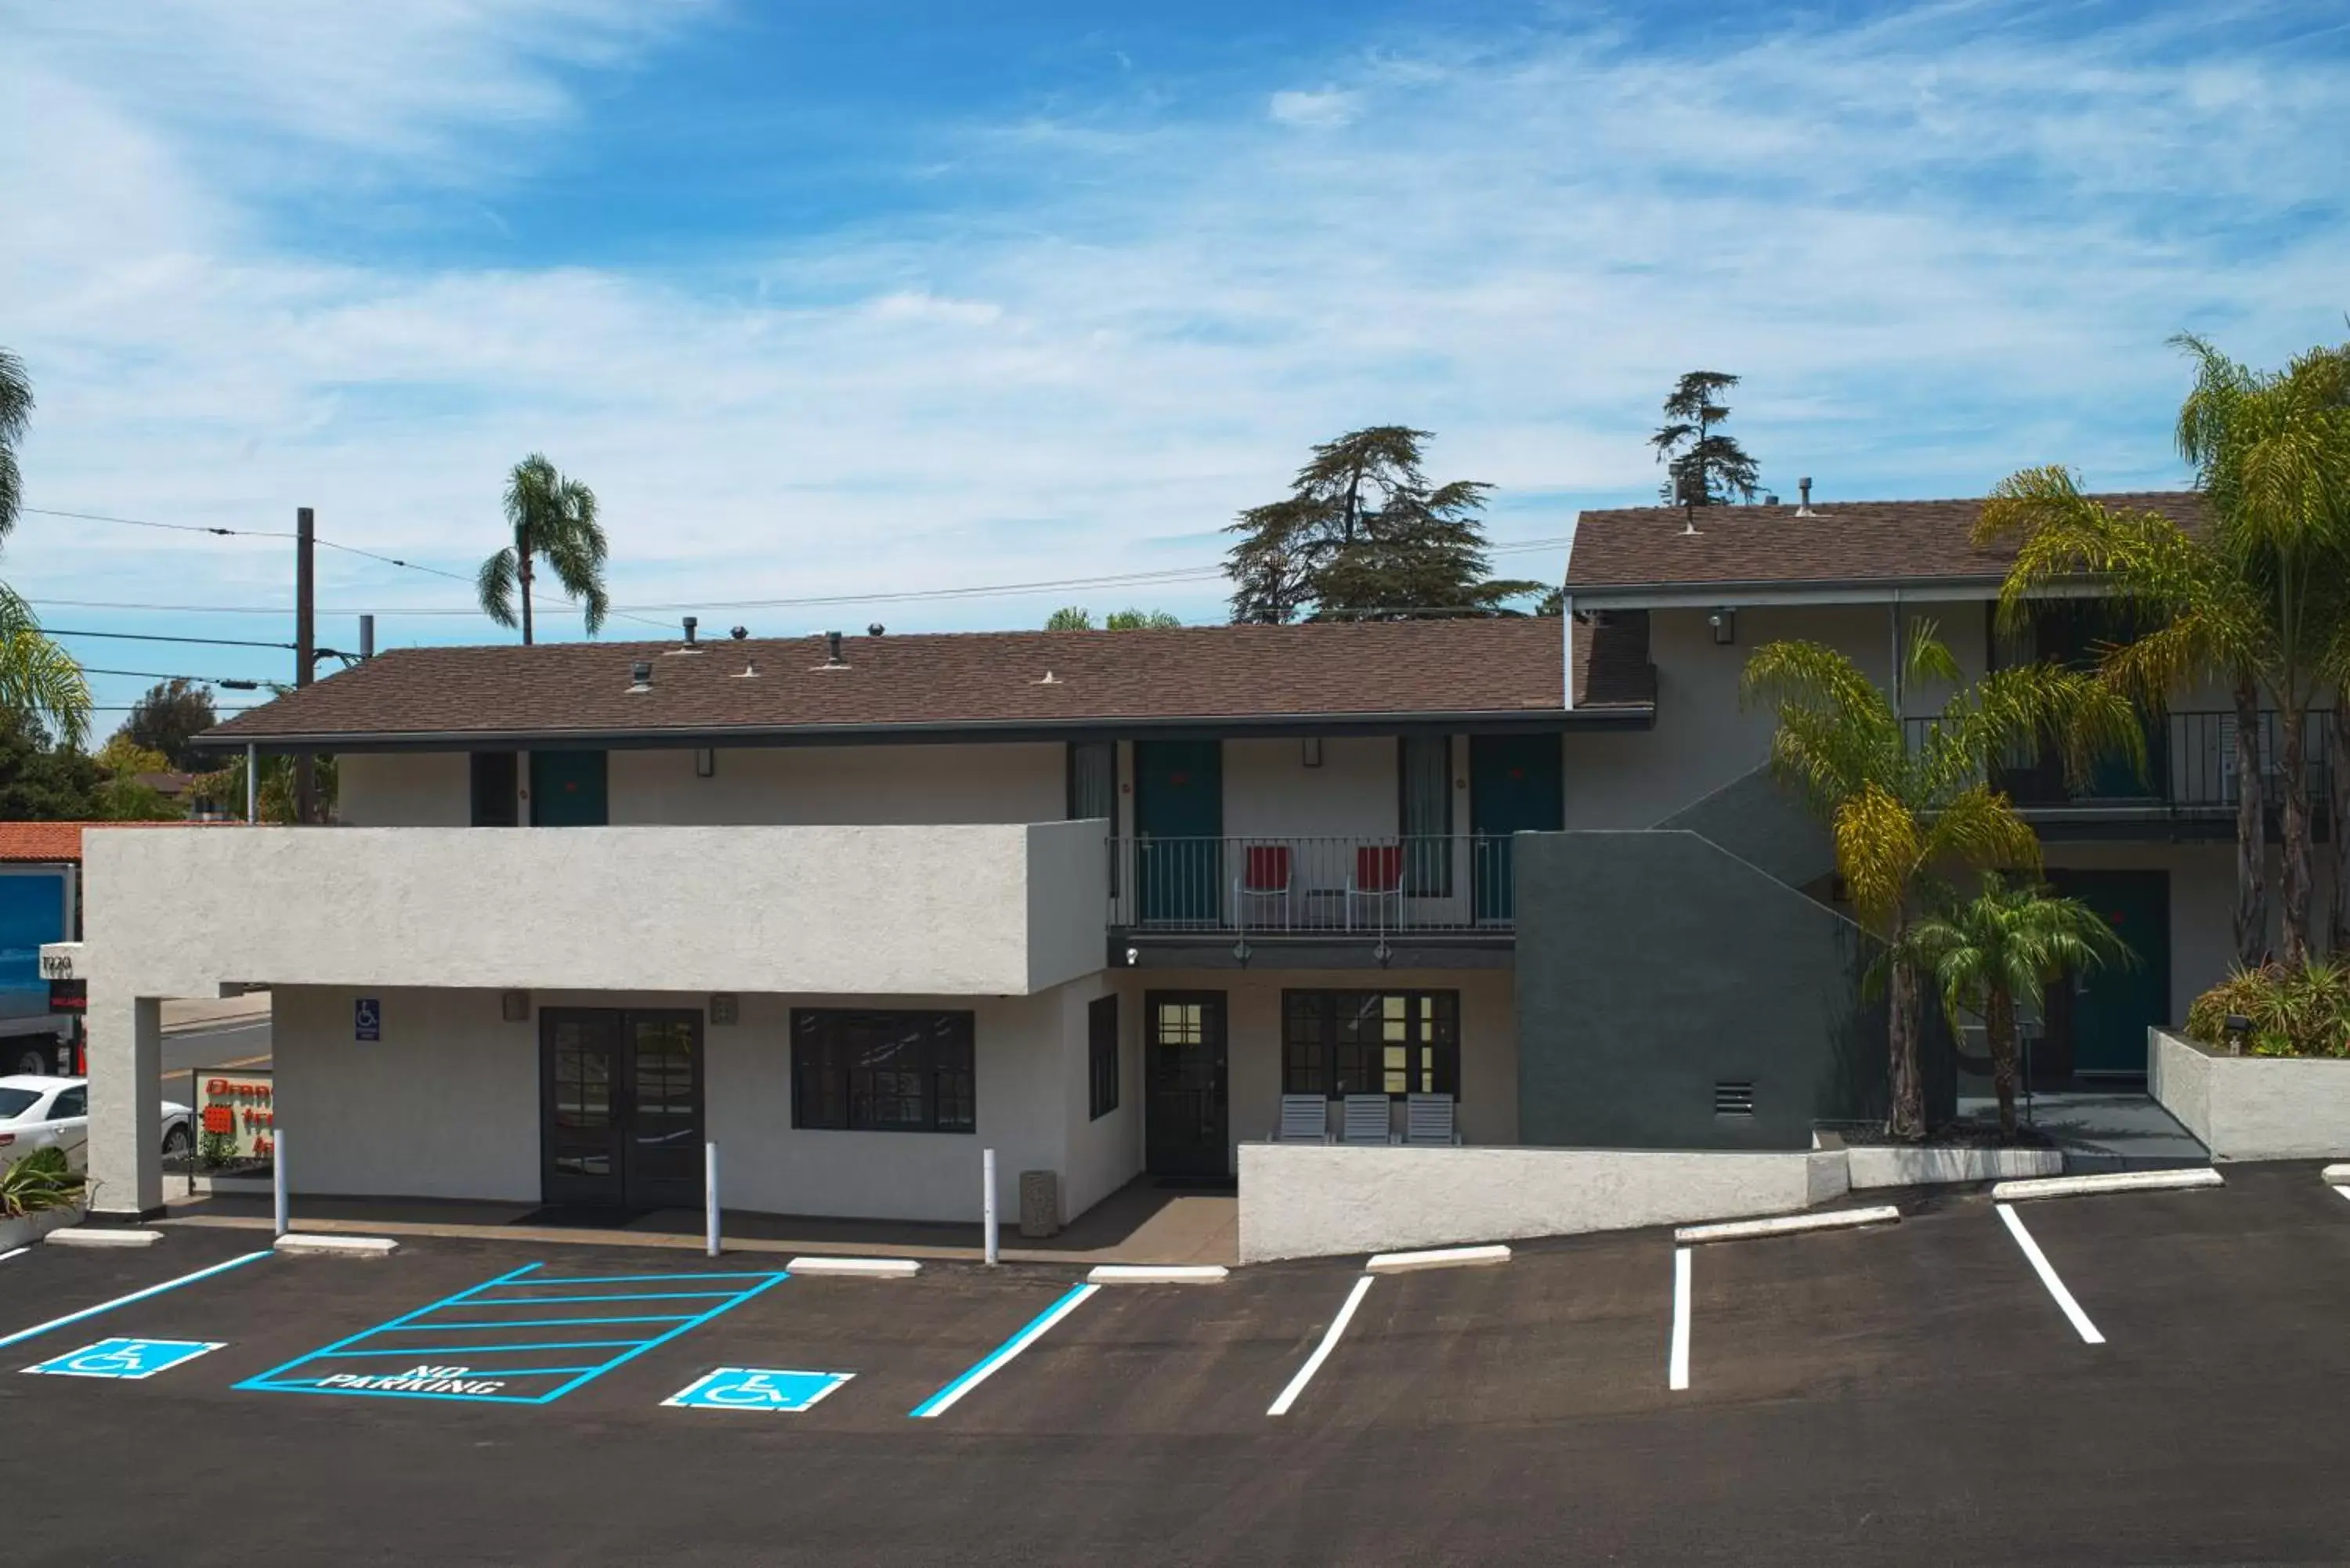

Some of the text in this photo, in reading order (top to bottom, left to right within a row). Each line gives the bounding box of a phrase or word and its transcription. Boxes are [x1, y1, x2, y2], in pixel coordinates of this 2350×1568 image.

[206, 1078, 273, 1097] Oran
[401, 1364, 470, 1379] NO
[314, 1373, 506, 1395] PARKING
